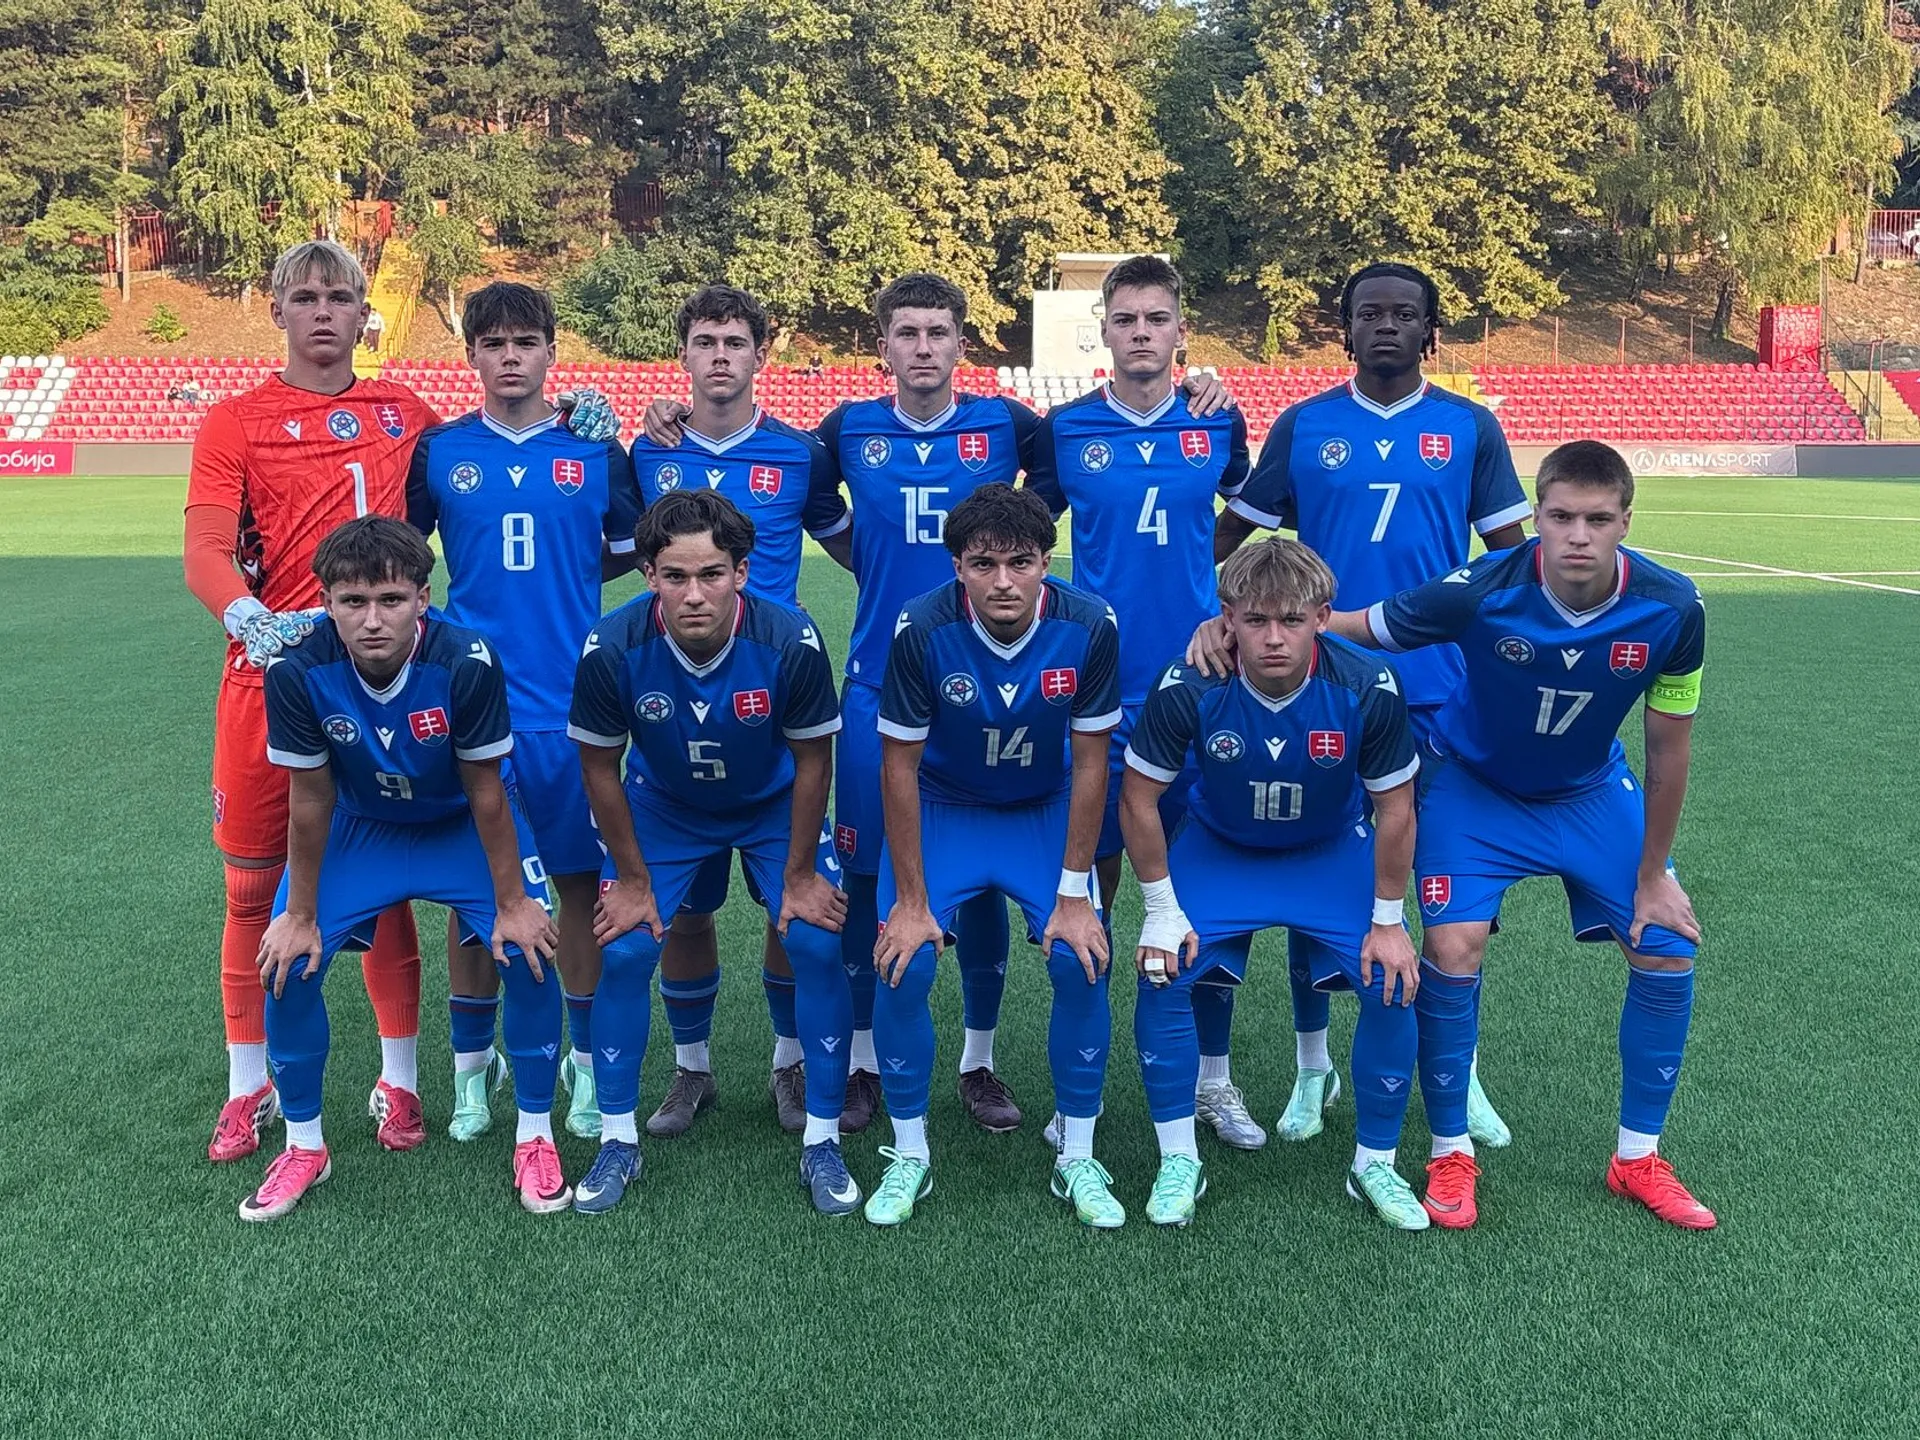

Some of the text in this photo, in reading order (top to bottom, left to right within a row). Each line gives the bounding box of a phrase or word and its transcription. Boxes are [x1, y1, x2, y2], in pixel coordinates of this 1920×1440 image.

[344, 462, 368, 519] 1
[900, 487, 949, 544] 15
[1368, 483, 1401, 543] 7
[502, 512, 535, 572] 8
[1136, 487, 1168, 546] 4
[1535, 686, 1594, 737] 17
[1656, 687, 1696, 699] RESPECT
[687, 740, 727, 782] 5
[982, 726, 1034, 768] 14
[375, 771, 413, 800] 9
[1248, 780, 1303, 822] 10
